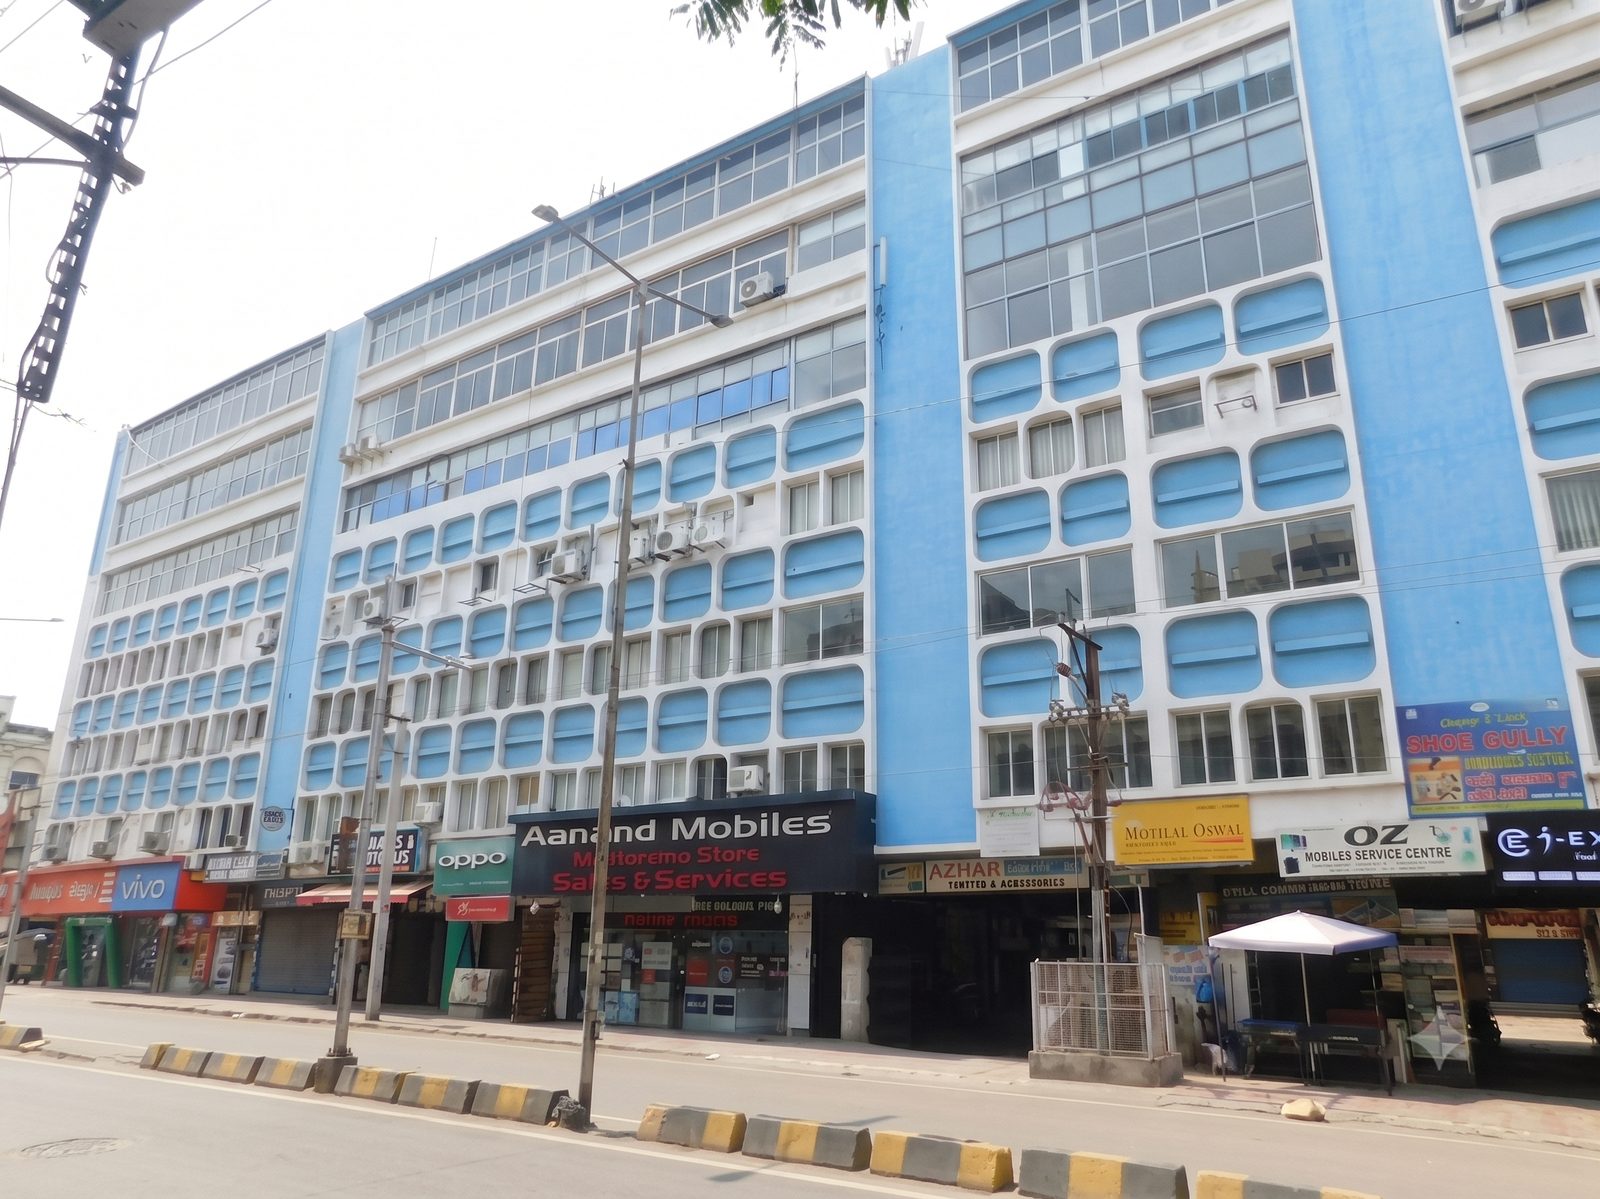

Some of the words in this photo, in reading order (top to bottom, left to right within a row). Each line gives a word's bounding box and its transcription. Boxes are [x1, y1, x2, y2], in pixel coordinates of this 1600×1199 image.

[1407, 732, 1474, 753] SHOE
[1483, 726, 1568, 750] GULLY
[672, 811, 832, 841] Mobiles
[1125, 826, 1188, 841] MOTILAL
[1193, 823, 1244, 838] OSWAL
[1344, 824, 1410, 846] OZ
[438, 852, 507, 870] oppo
[697, 846, 760, 864] Store
[1305, 850, 1352, 862] MOBILES
[1355, 849, 1401, 860] SERVICE
[1406, 847, 1452, 859] CENTRE
[634, 871, 651, 890] &
[655, 868, 788, 891] Services
[929, 860, 1001, 881] AZHAR
[122, 874, 166, 900] vivo
